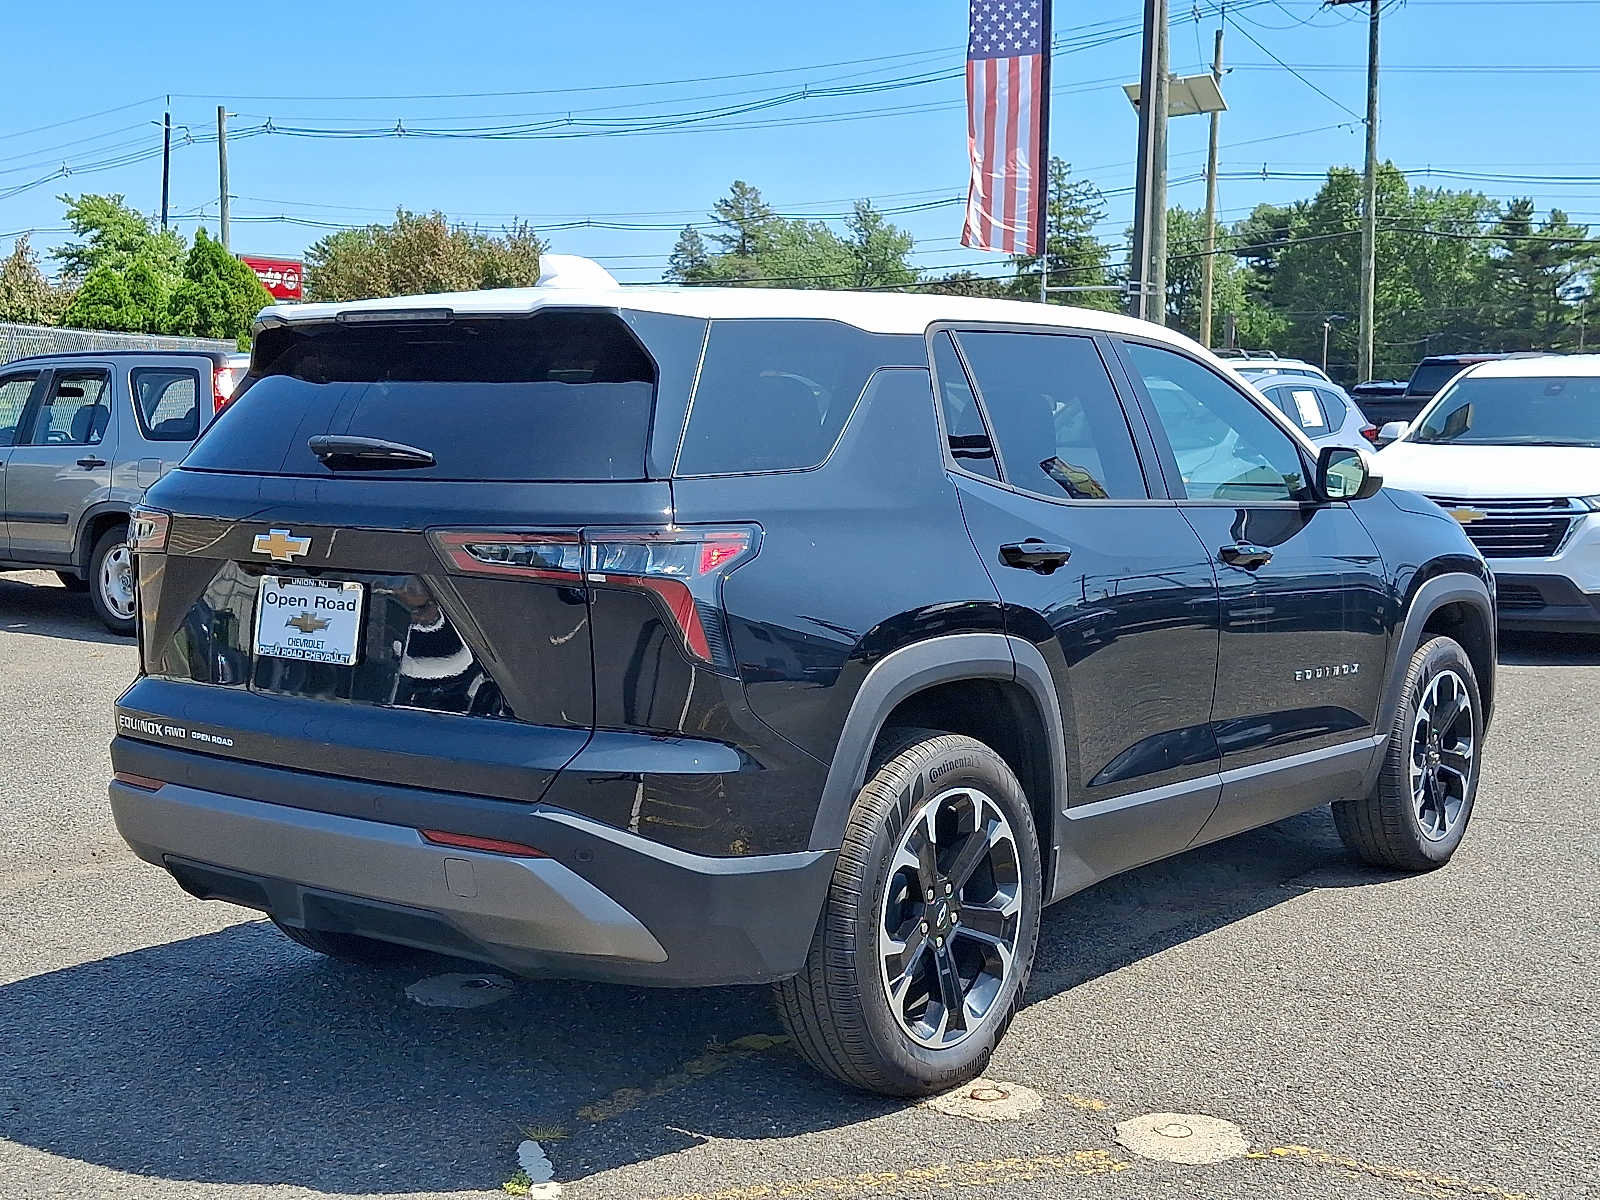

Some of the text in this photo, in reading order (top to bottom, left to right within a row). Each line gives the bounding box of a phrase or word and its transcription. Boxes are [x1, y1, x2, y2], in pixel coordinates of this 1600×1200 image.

[318, 580, 329, 588] NJ
[265, 591, 356, 611] Open Road
[287, 637, 325, 649] CHEVROLET
[259, 646, 350, 664] OPEN ROAD CHEVROLET
[1294, 663, 1360, 681] EQUINOX
[119, 714, 186, 738] EQUINOX AWD
[191, 731, 233, 747] OPEN ROAD
[928, 754, 974, 784] Continental
